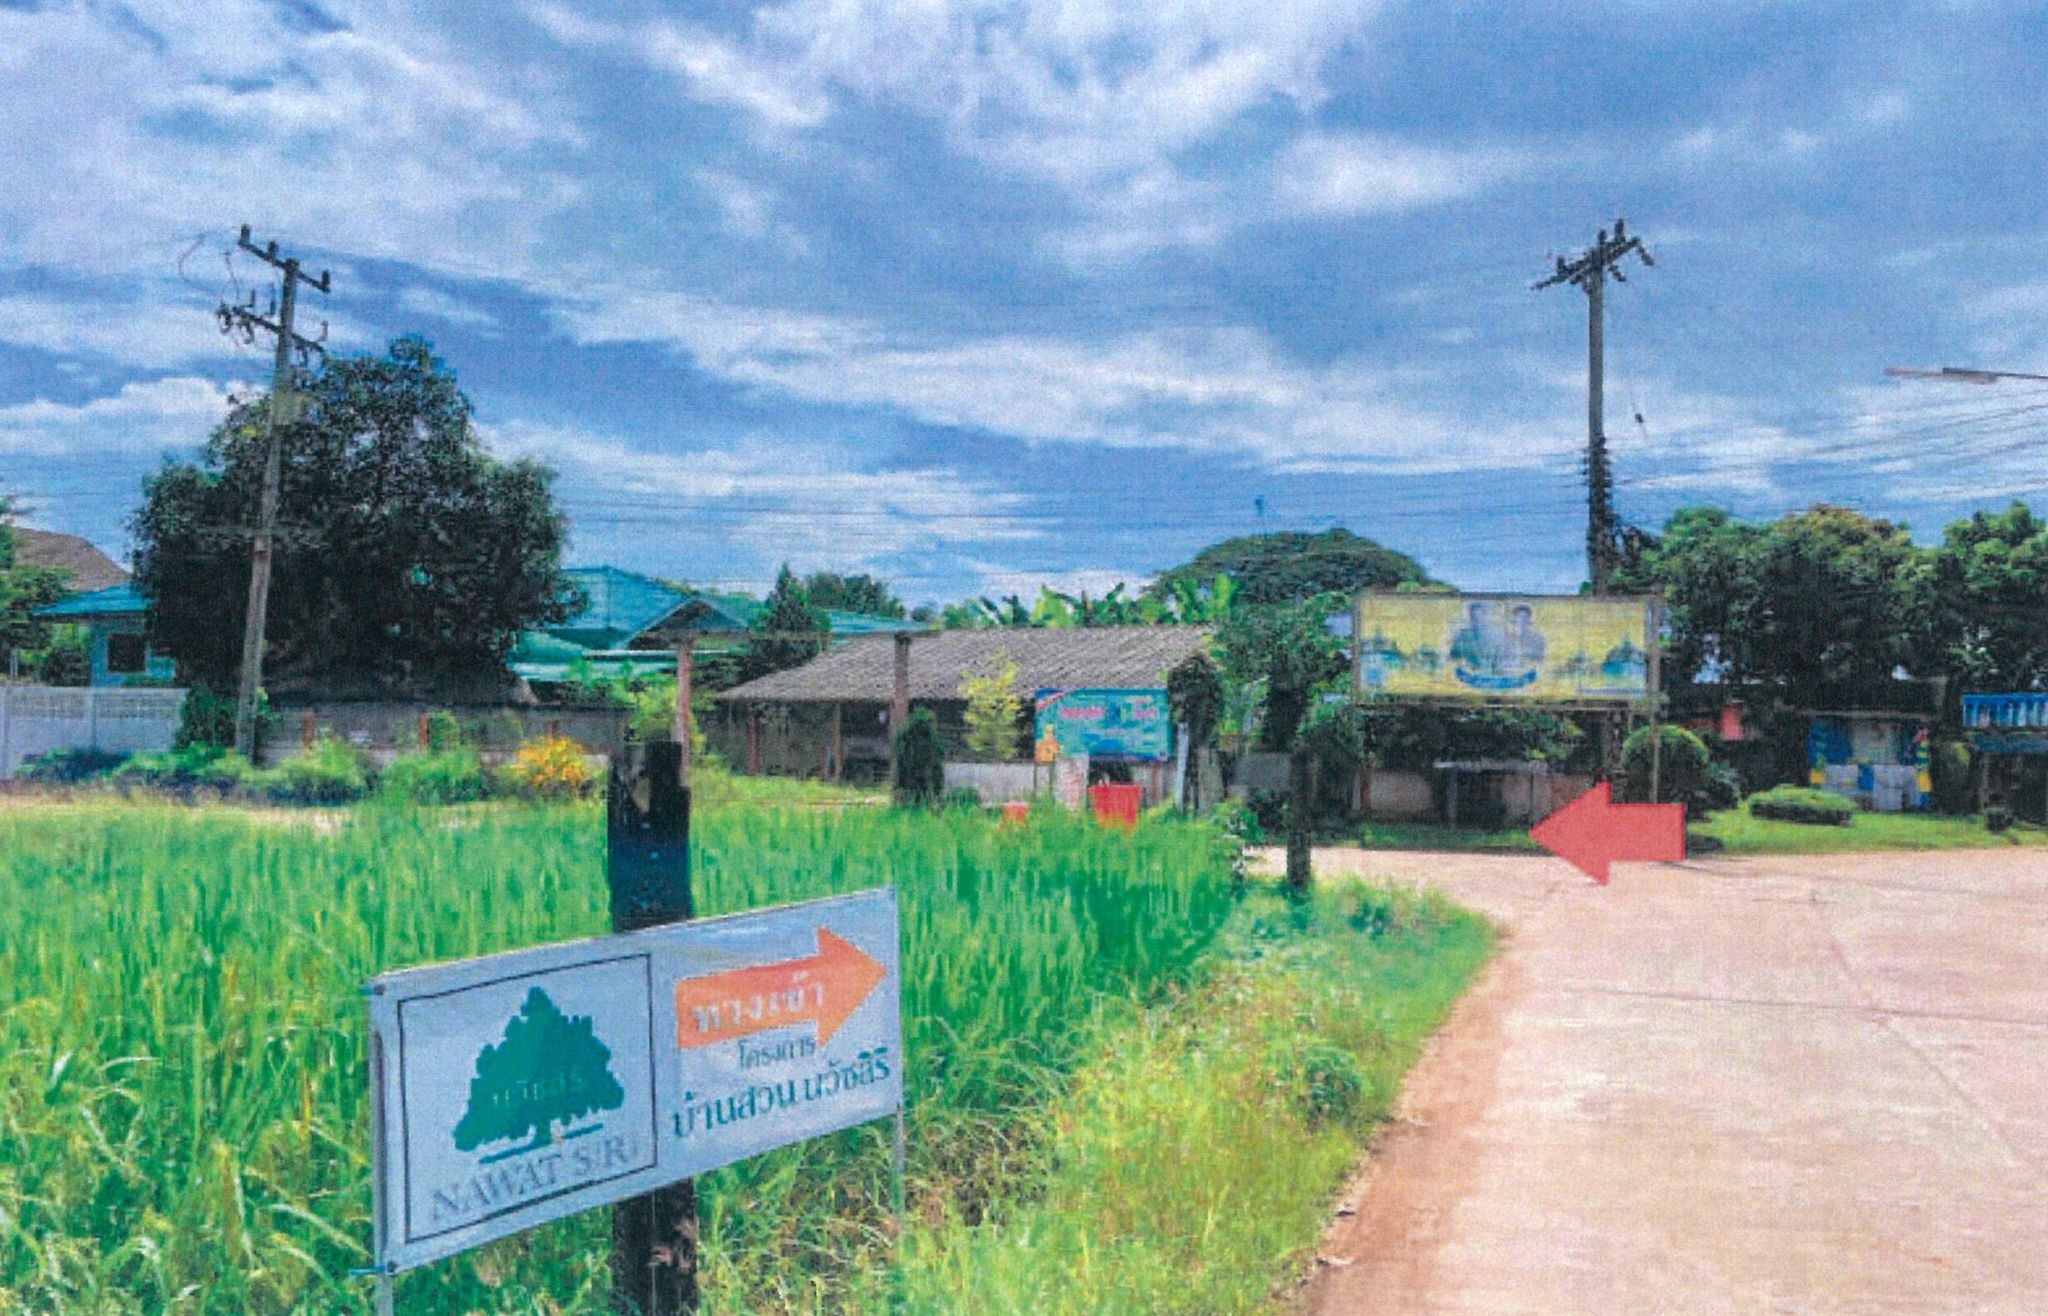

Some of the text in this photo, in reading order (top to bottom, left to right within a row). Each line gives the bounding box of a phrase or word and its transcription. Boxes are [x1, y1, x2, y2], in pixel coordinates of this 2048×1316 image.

[691, 970, 825, 1034] ทางเข้า
[738, 1034, 817, 1070] โครงการ
[433, 1153, 563, 1222] NAWAT
